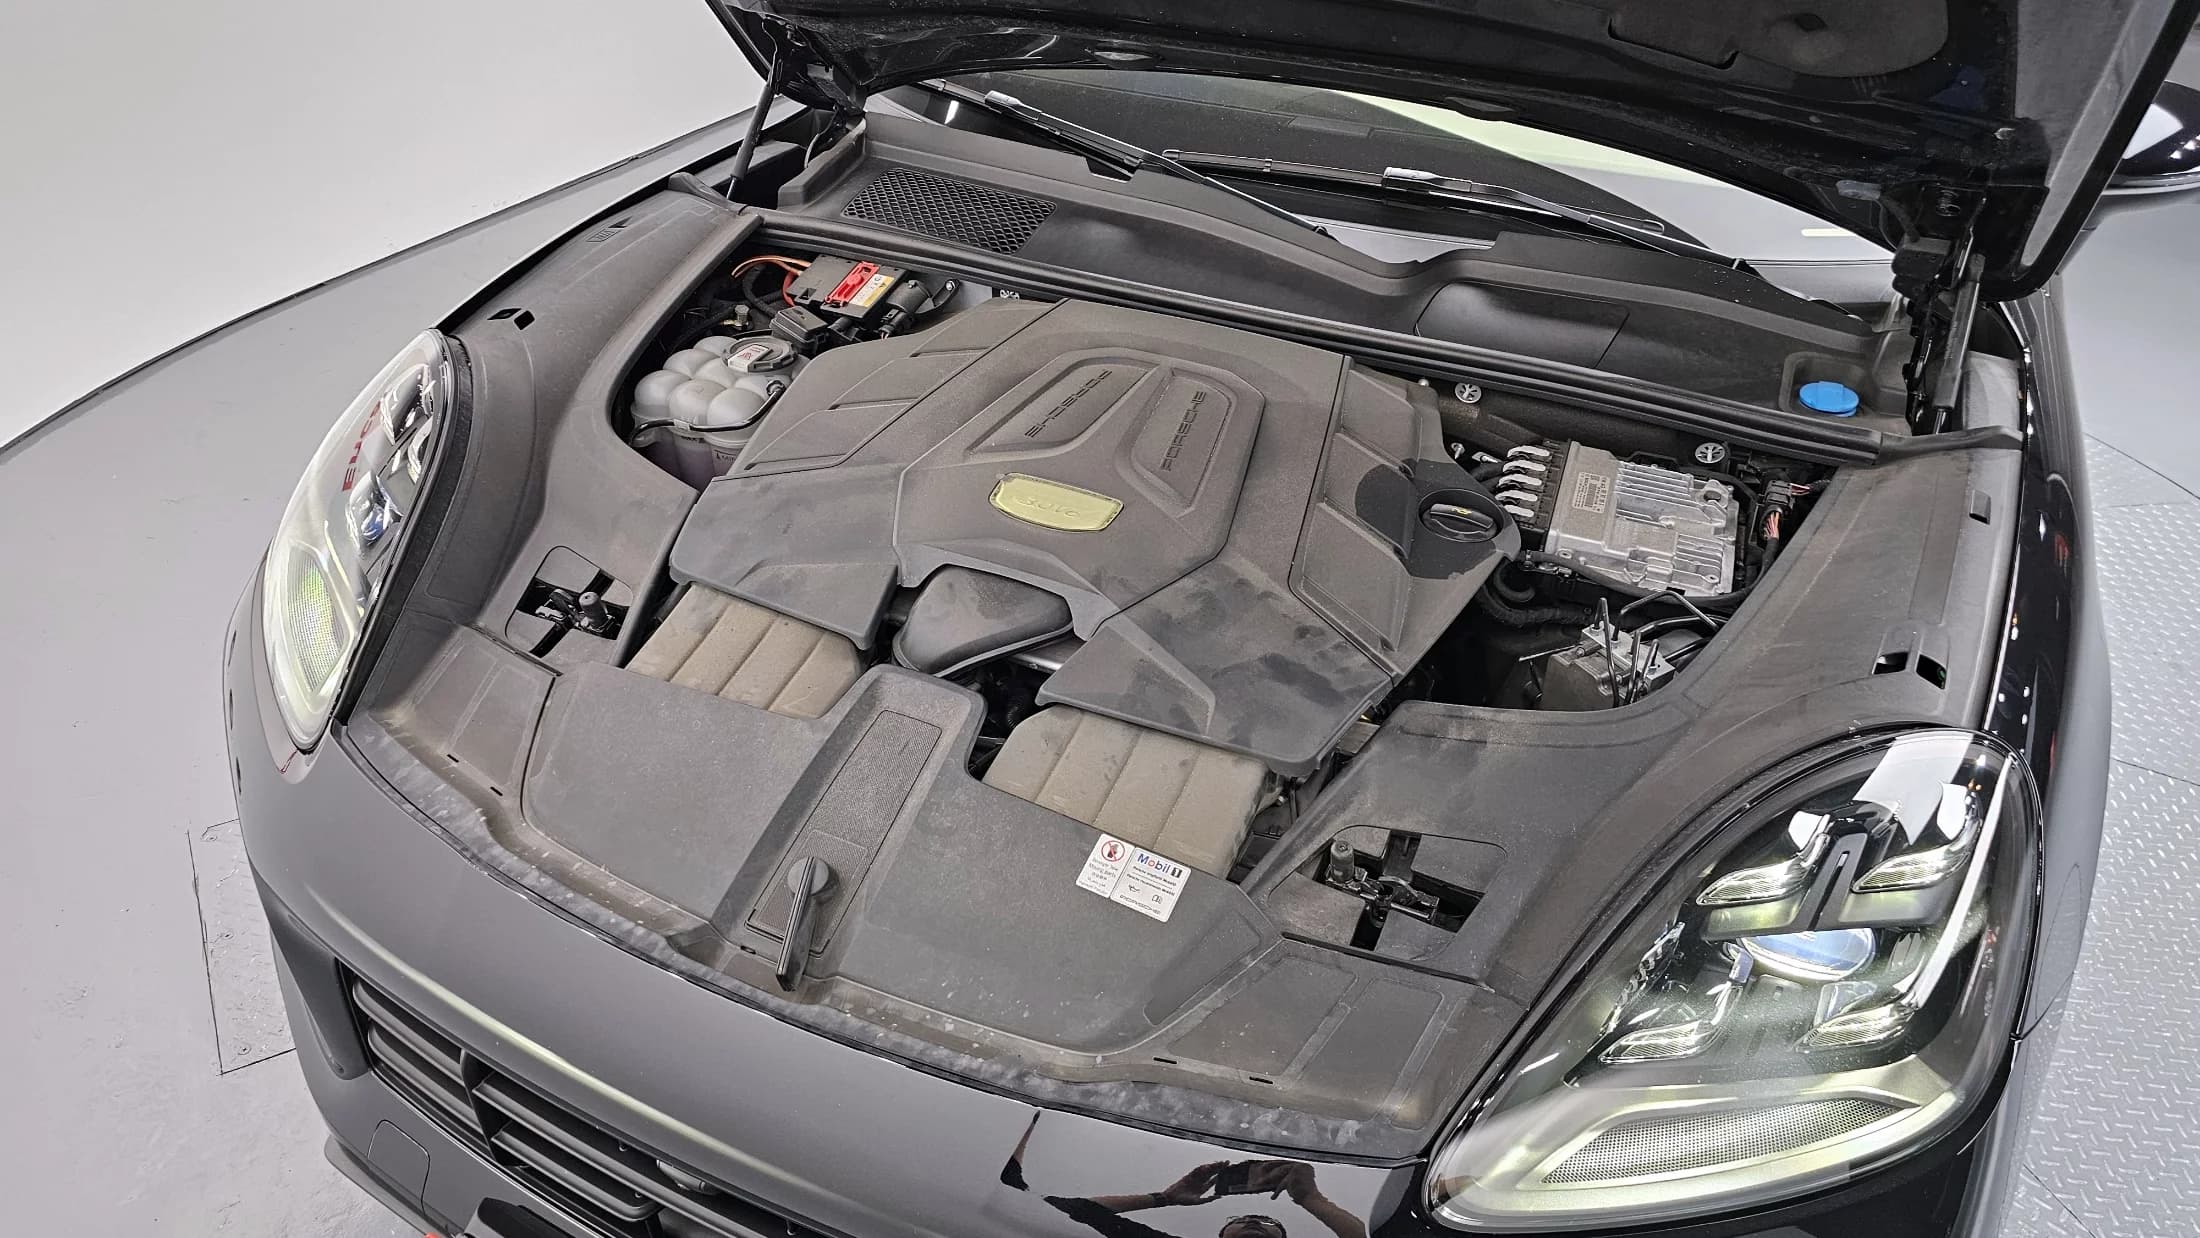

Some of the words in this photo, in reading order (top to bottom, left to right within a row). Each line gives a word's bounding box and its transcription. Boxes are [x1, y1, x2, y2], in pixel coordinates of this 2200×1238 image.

[1024, 368, 1113, 438] PORSCHE
[1160, 390, 1207, 471] PORSCHE
[1137, 854, 1171, 874] Mobil
[1171, 867, 1183, 878] 1
